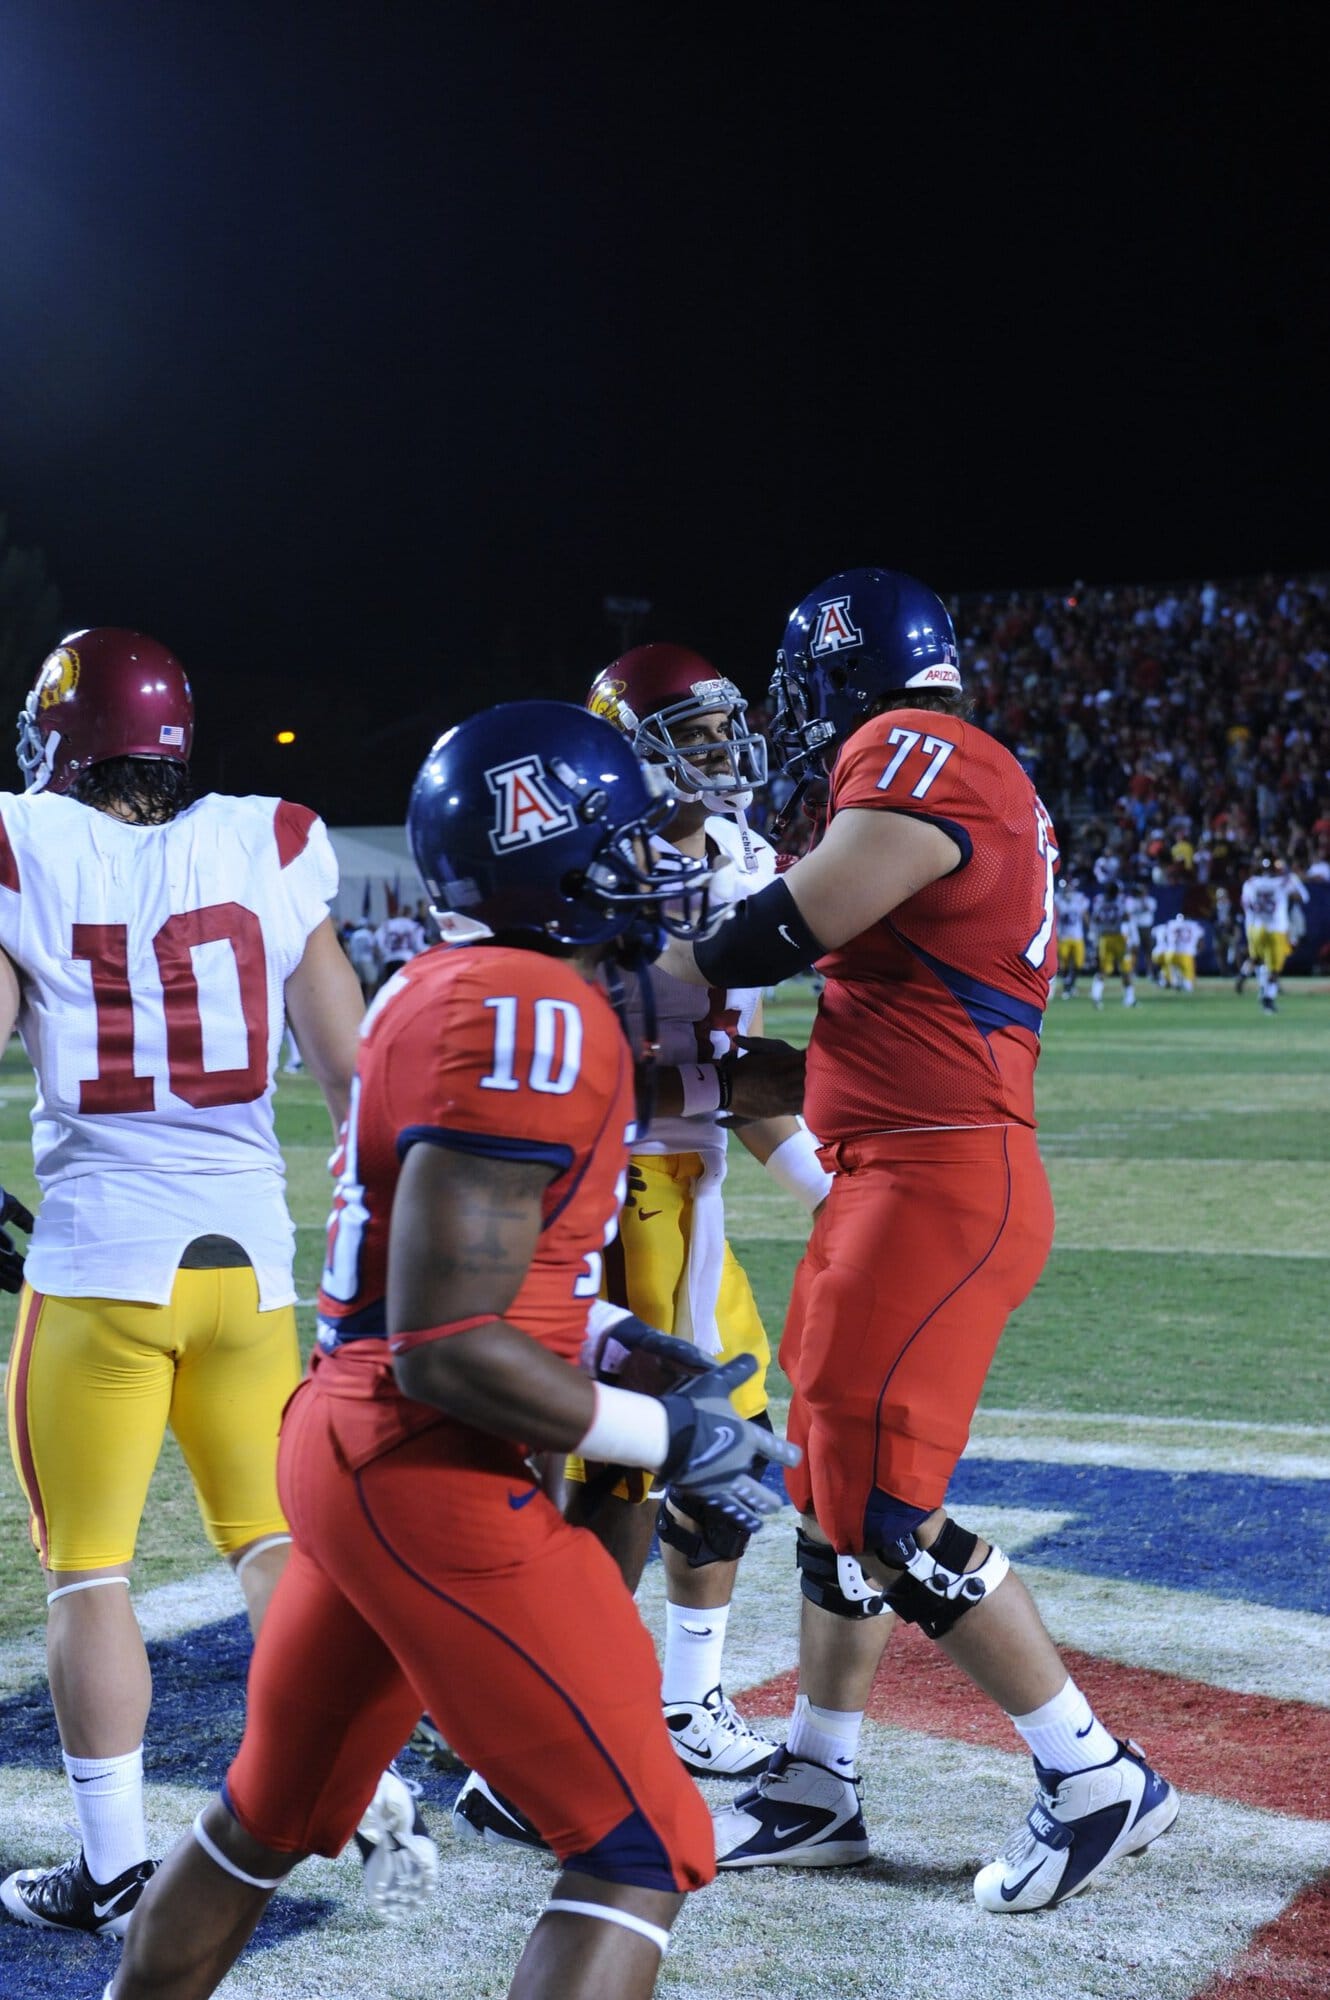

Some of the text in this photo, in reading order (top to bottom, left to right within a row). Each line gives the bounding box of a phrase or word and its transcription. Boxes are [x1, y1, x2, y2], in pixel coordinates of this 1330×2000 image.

[810, 595, 864, 659] A
[924, 670, 960, 683] ARIZON
[876, 726, 955, 800] 77
[483, 754, 579, 856] A
[71, 901, 269, 1114] 10
[478, 995, 584, 1096] 10
[1029, 1808, 1054, 1837] NIKE
